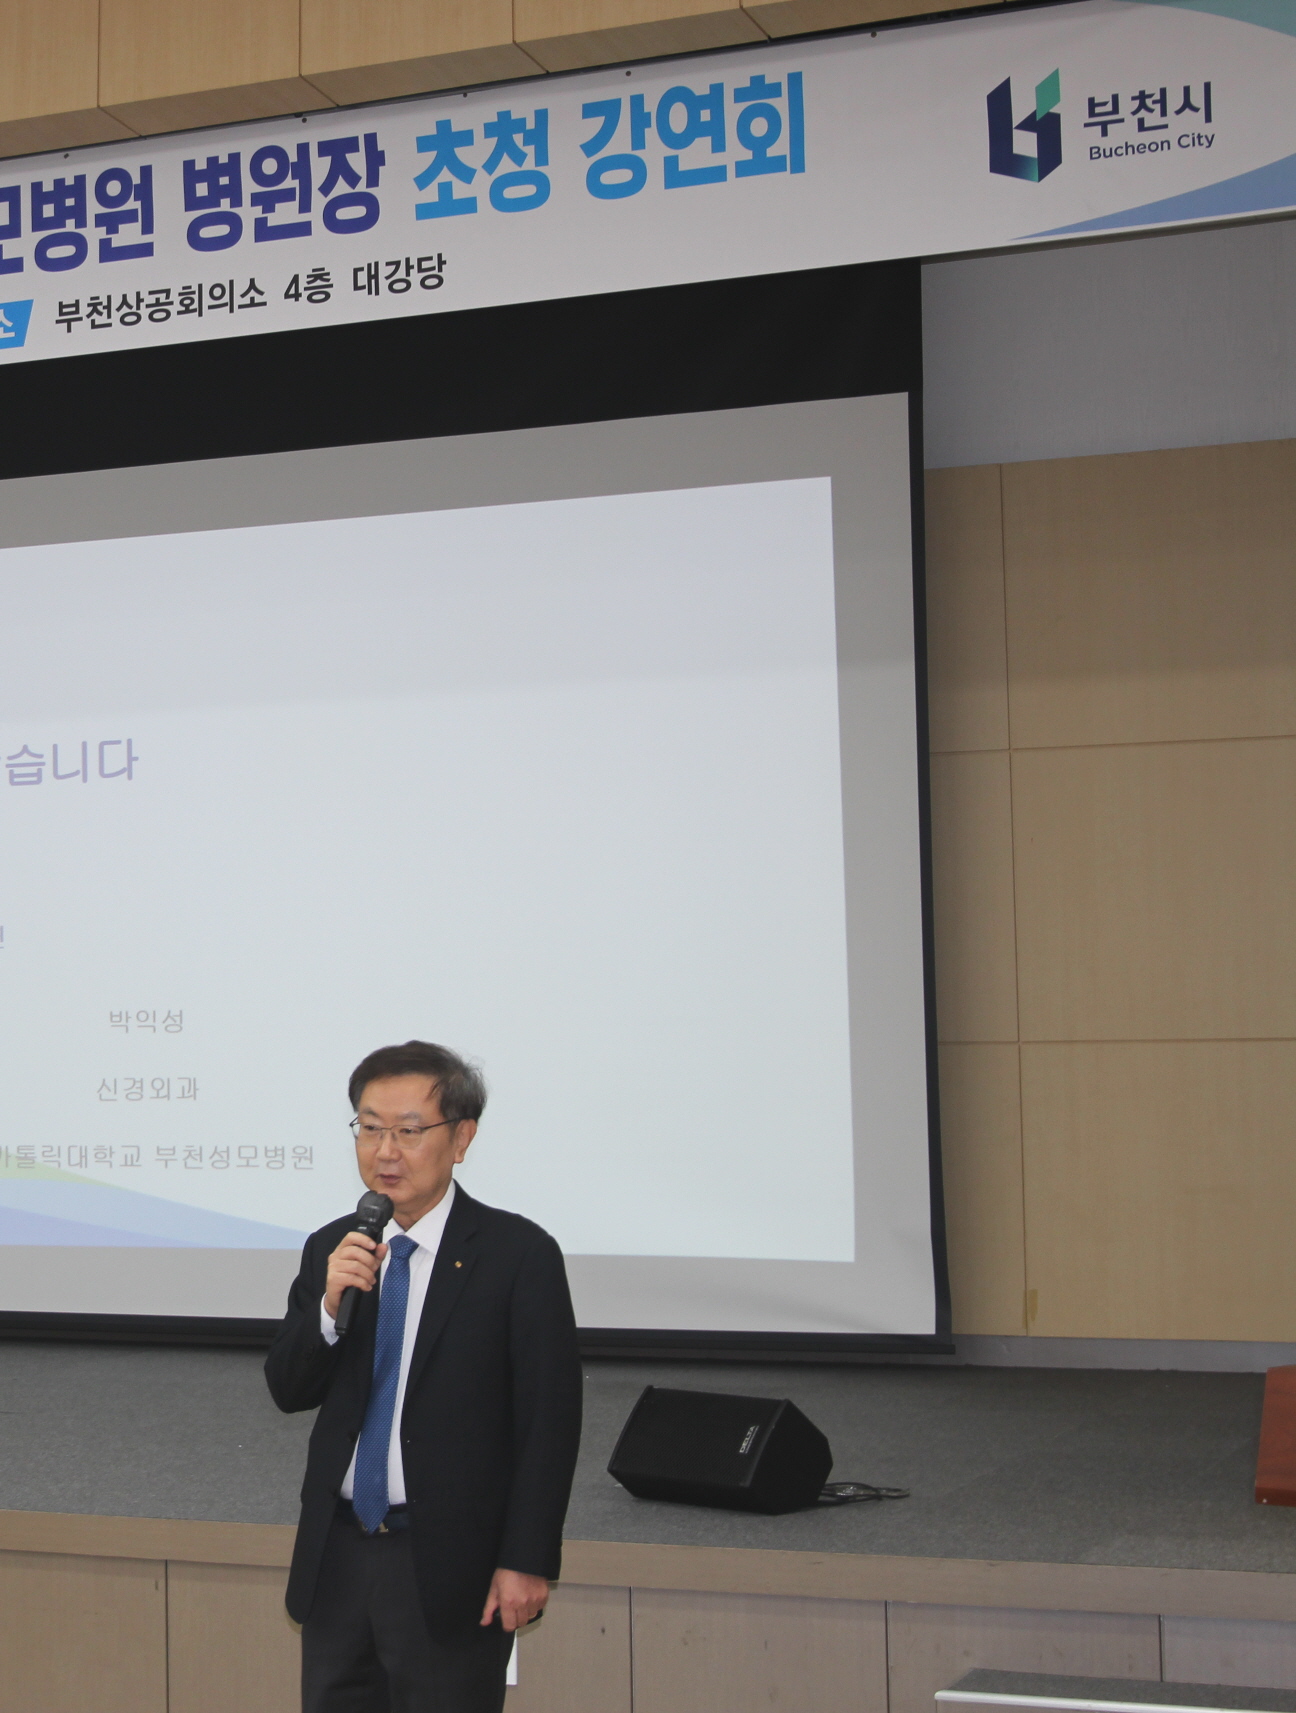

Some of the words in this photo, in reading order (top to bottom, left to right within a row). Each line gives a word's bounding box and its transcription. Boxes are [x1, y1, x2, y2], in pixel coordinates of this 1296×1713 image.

[1083, 81, 1214, 137] 부천시
[1088, 139, 1171, 161] Bucheon
[1177, 131, 1215, 151] City
[183, 132, 385, 252] 병원장
[413, 107, 551, 221] 초청
[581, 71, 805, 200] 강연회
[56, 277, 267, 334] 부천상공회의소
[283, 266, 334, 303] 4층
[353, 253, 447, 298] 대강당
[109, 1009, 185, 1034] 박익성
[96, 1077, 200, 1102] 신경외과
[154, 1145, 315, 1170] 부천성모병원
[739, 1425, 756, 1453] DELTA
